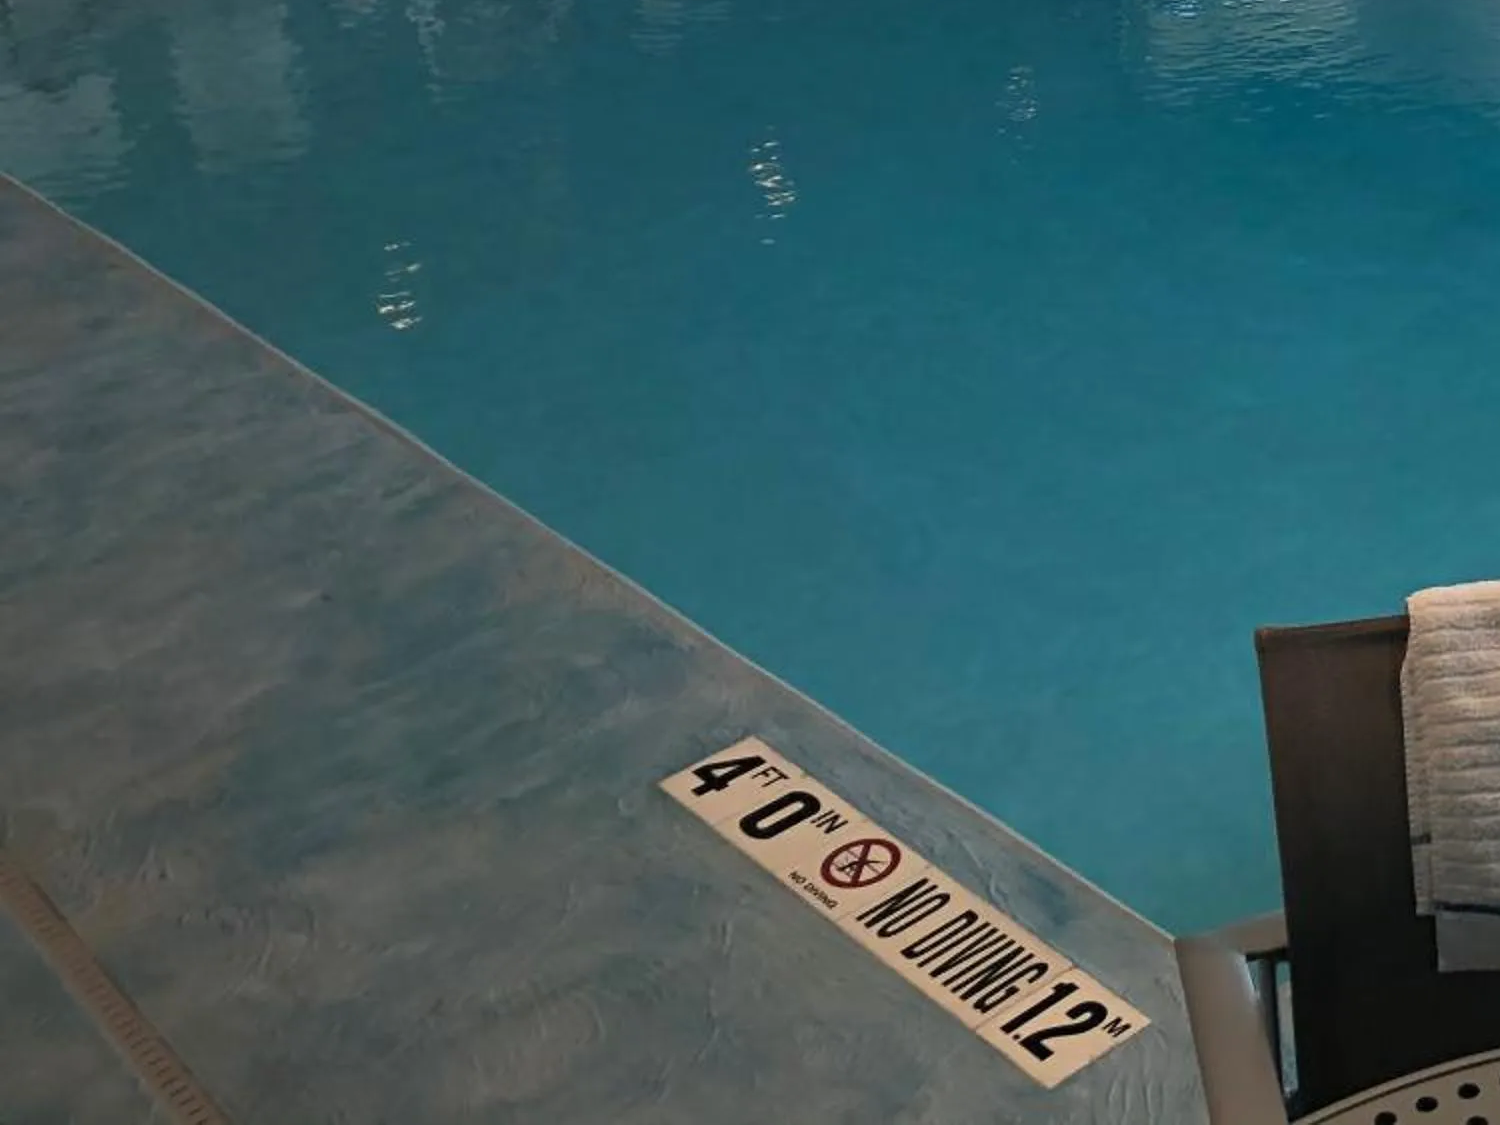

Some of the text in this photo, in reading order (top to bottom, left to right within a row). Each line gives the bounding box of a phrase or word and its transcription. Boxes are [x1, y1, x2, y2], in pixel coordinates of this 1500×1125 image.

[788, 871, 839, 910] NO DIVING
[856, 878, 950, 937] NO
[900, 910, 1049, 1013] DIVING
